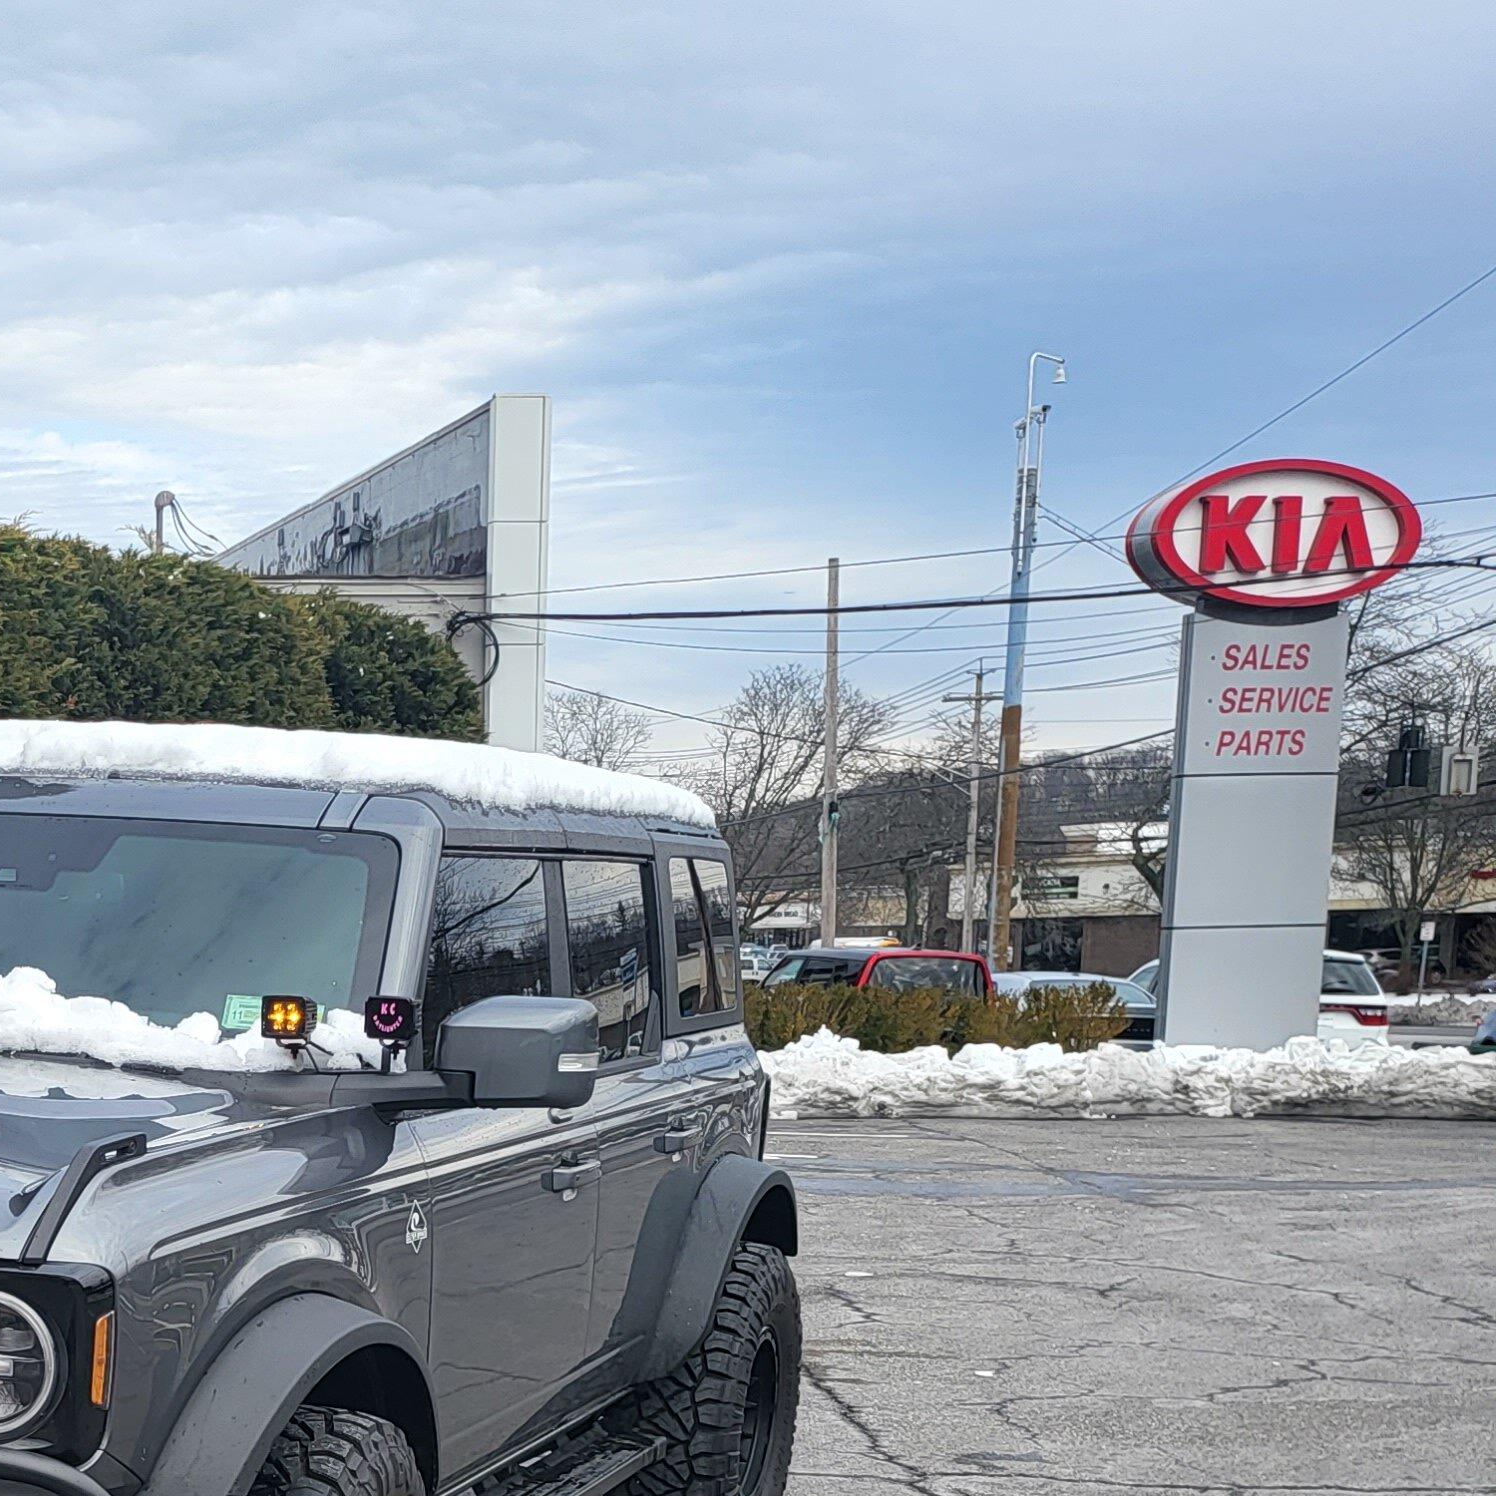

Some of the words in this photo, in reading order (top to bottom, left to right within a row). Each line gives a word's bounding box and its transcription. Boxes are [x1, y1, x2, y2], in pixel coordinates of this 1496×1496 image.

[1199, 495, 1374, 574] KIA
[1221, 643, 1311, 671] SALES
[1218, 686, 1333, 713] SERVICE
[1215, 729, 1306, 757] PARTS
[381, 1002, 396, 1015] KC
